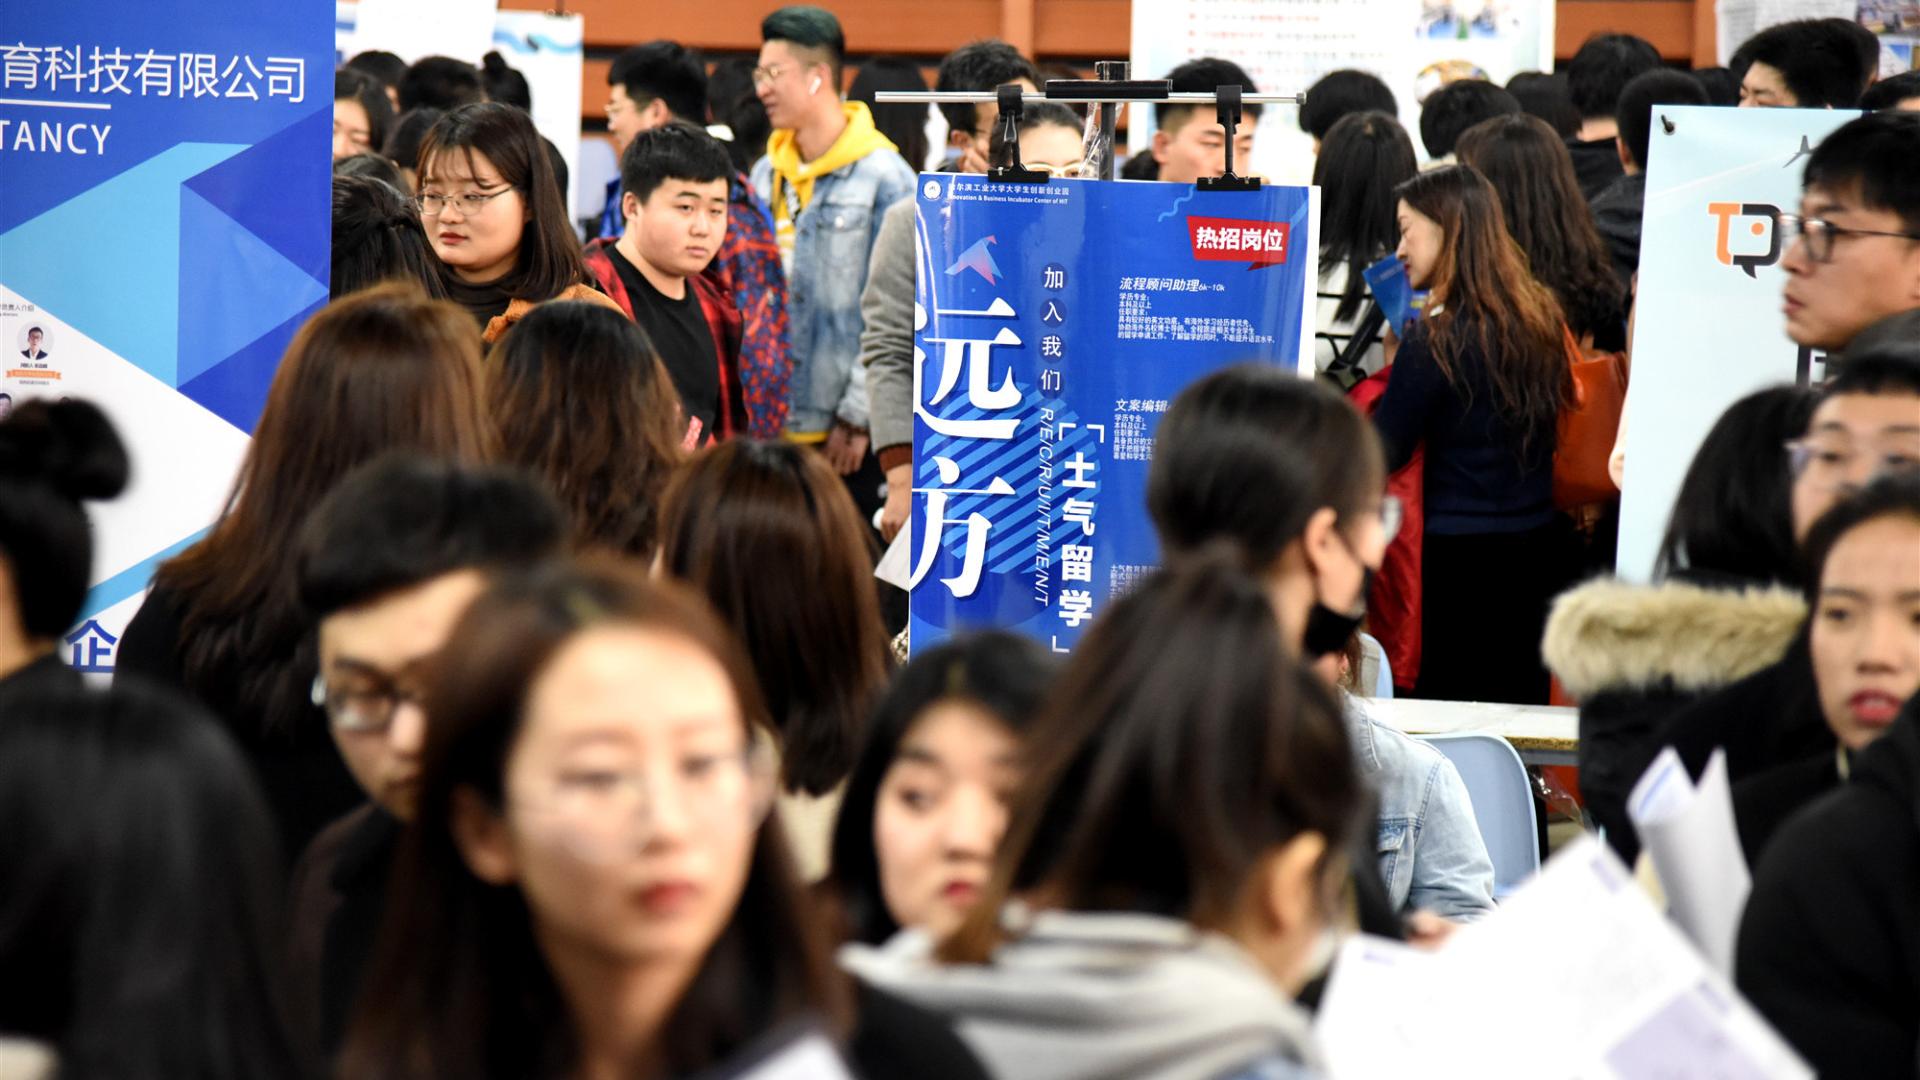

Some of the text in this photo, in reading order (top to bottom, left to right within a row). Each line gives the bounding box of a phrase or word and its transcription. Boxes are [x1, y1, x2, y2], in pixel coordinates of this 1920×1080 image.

[0, 42, 305, 103] 育科技有限公司
[1196, 227, 1283, 251] 热招岗位
[1041, 267, 1064, 391] 加入我们
[1114, 398, 1170, 412] 文案编辑
[909, 297, 1022, 598] 远方
[1114, 437, 1157, 446] 具备良好的文
[63, 620, 118, 673] 企
